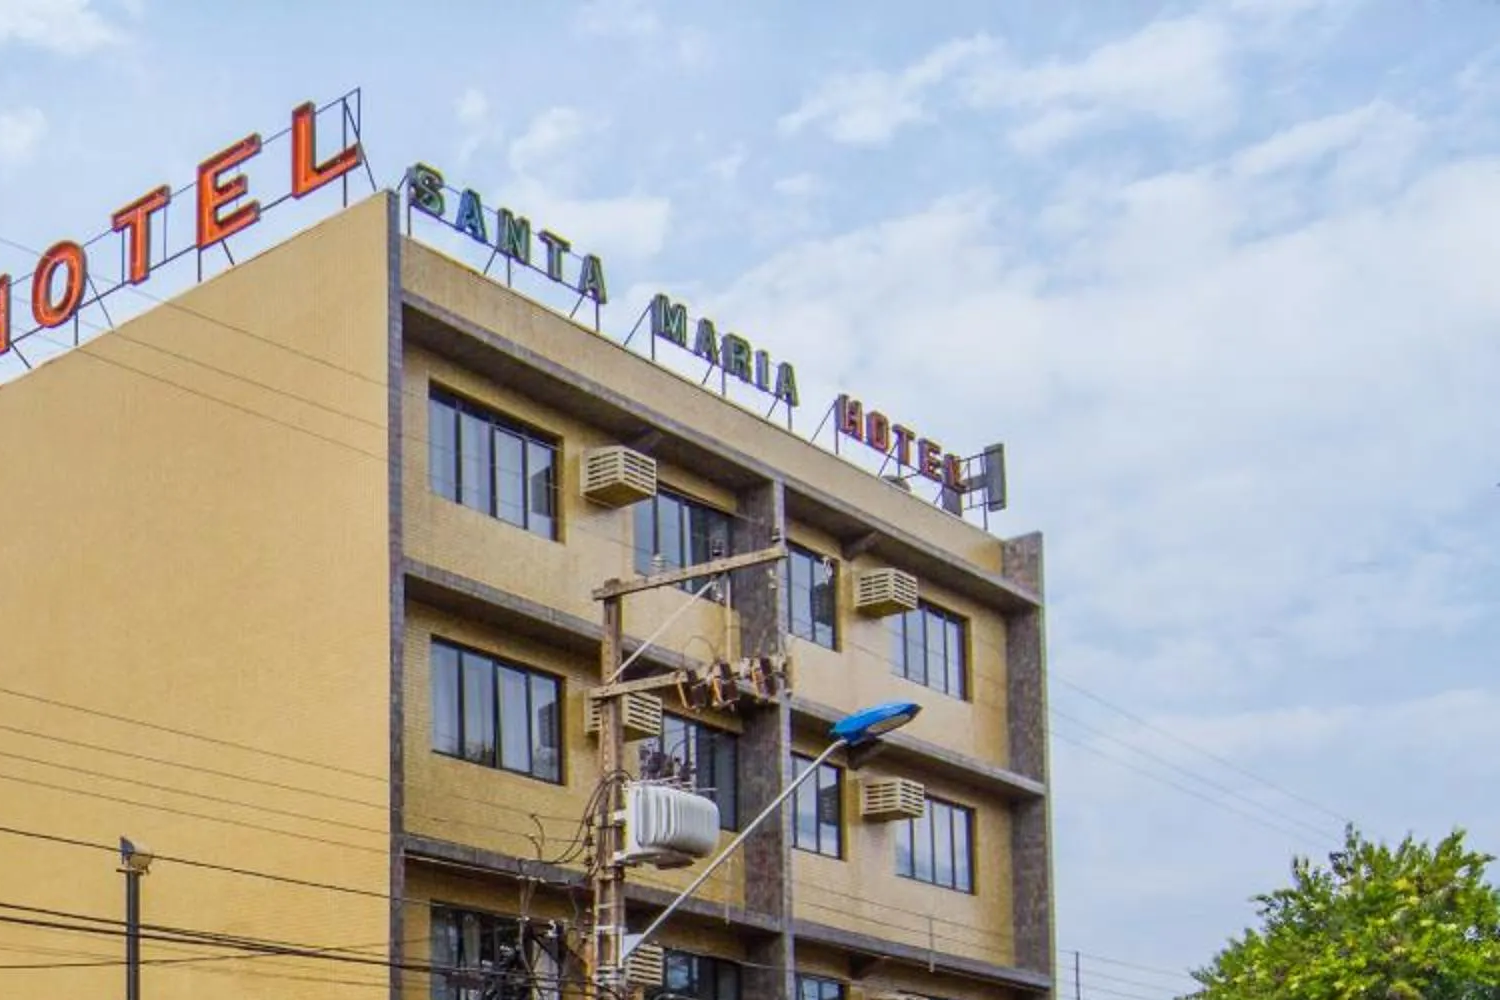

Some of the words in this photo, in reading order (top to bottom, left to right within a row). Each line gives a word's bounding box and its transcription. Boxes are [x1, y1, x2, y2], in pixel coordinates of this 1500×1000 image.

[407, 161, 607, 304] SANTA
[651, 293, 799, 406] MARIA
[835, 393, 966, 494] HOTEL
